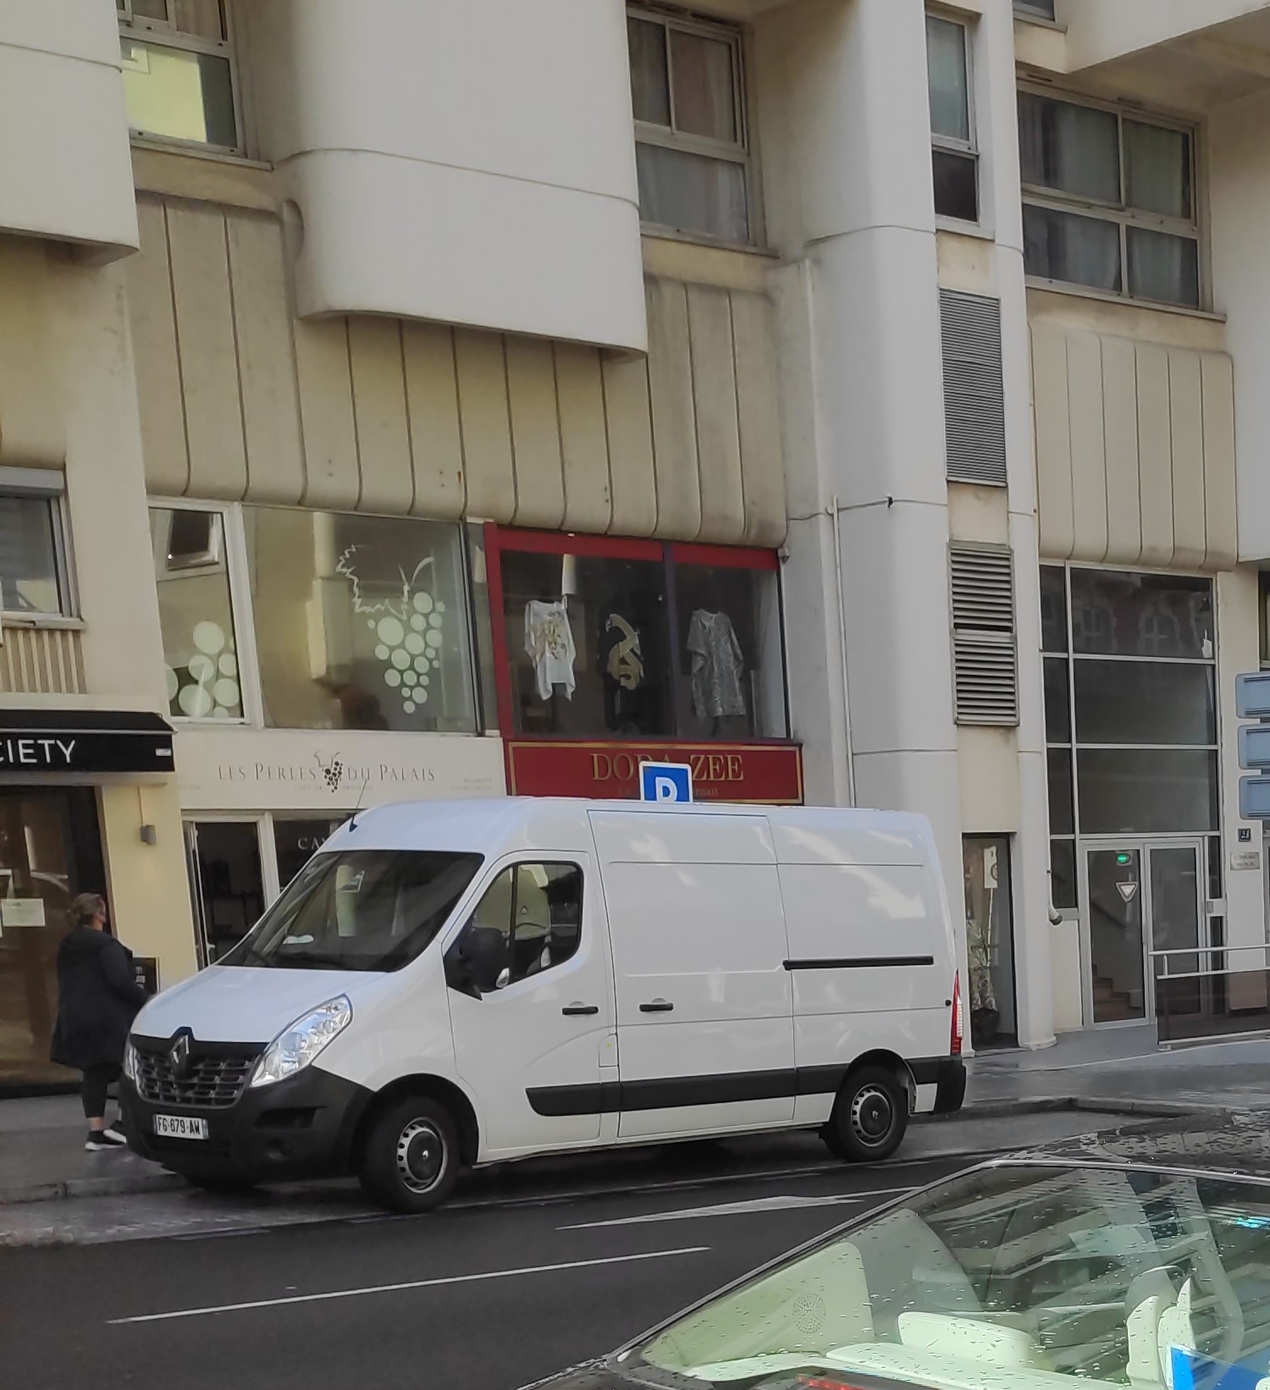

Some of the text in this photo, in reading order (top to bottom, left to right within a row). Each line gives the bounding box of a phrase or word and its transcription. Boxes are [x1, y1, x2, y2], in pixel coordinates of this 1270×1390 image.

[0, 739, 76, 764] IETY
[218, 762, 436, 781] LES PERLES DU PALAIS
[689, 754, 745, 781] ZEE
[655, 776, 678, 802] P
